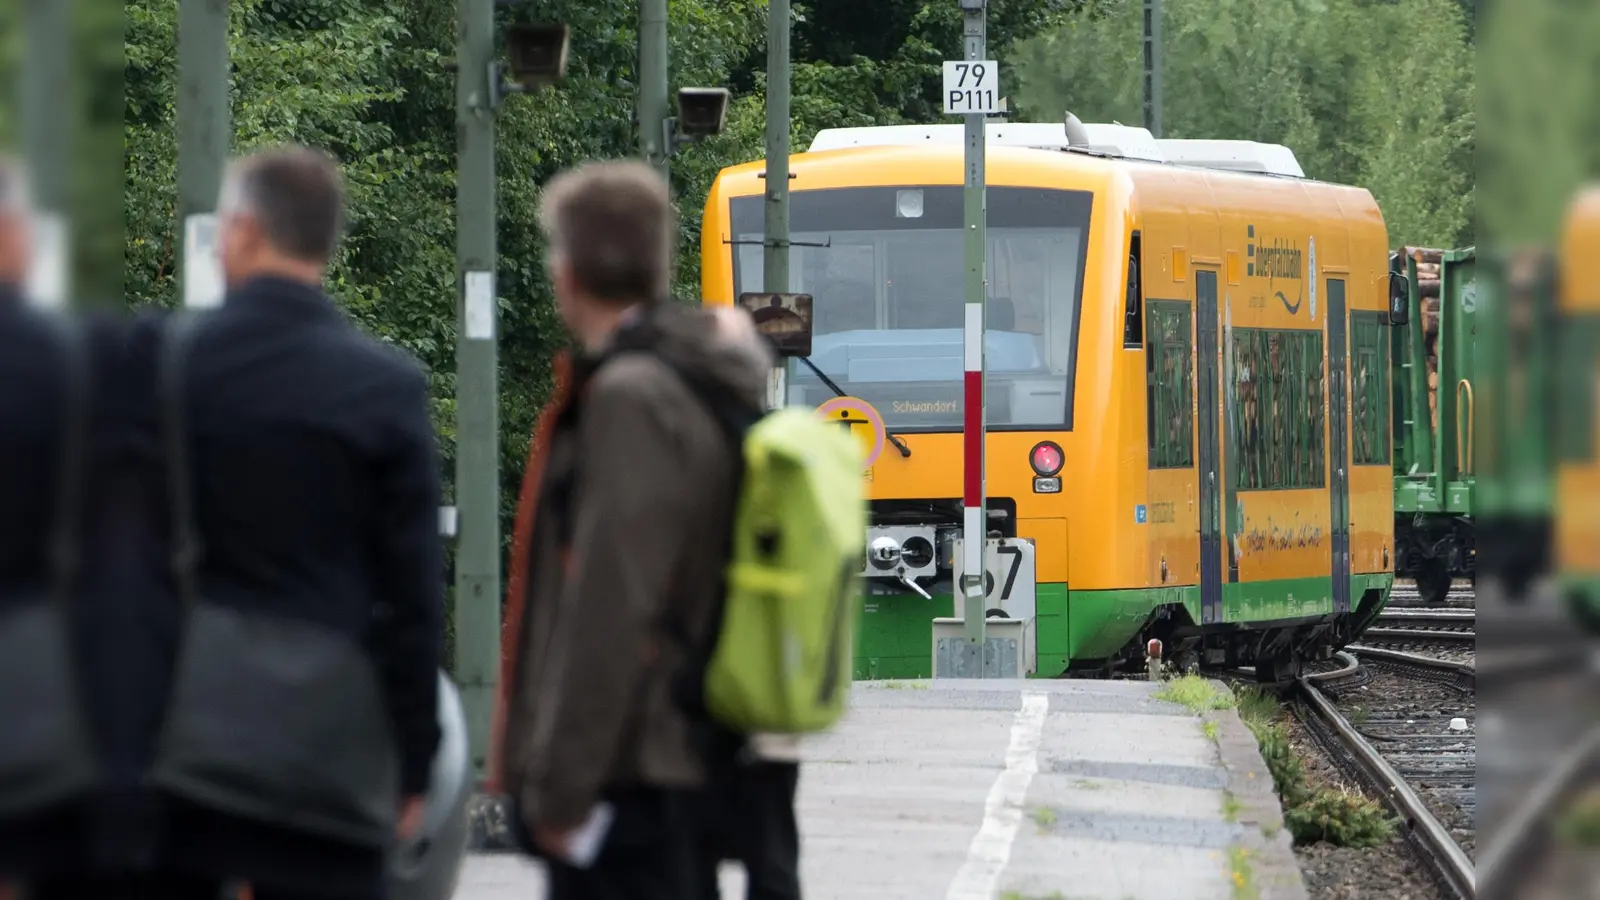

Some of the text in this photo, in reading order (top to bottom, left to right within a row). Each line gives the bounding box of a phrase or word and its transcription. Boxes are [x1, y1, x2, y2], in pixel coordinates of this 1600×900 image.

[956, 64, 985, 87] 79
[950, 90, 992, 110] P111
[892, 400, 957, 413] Schwandorf
